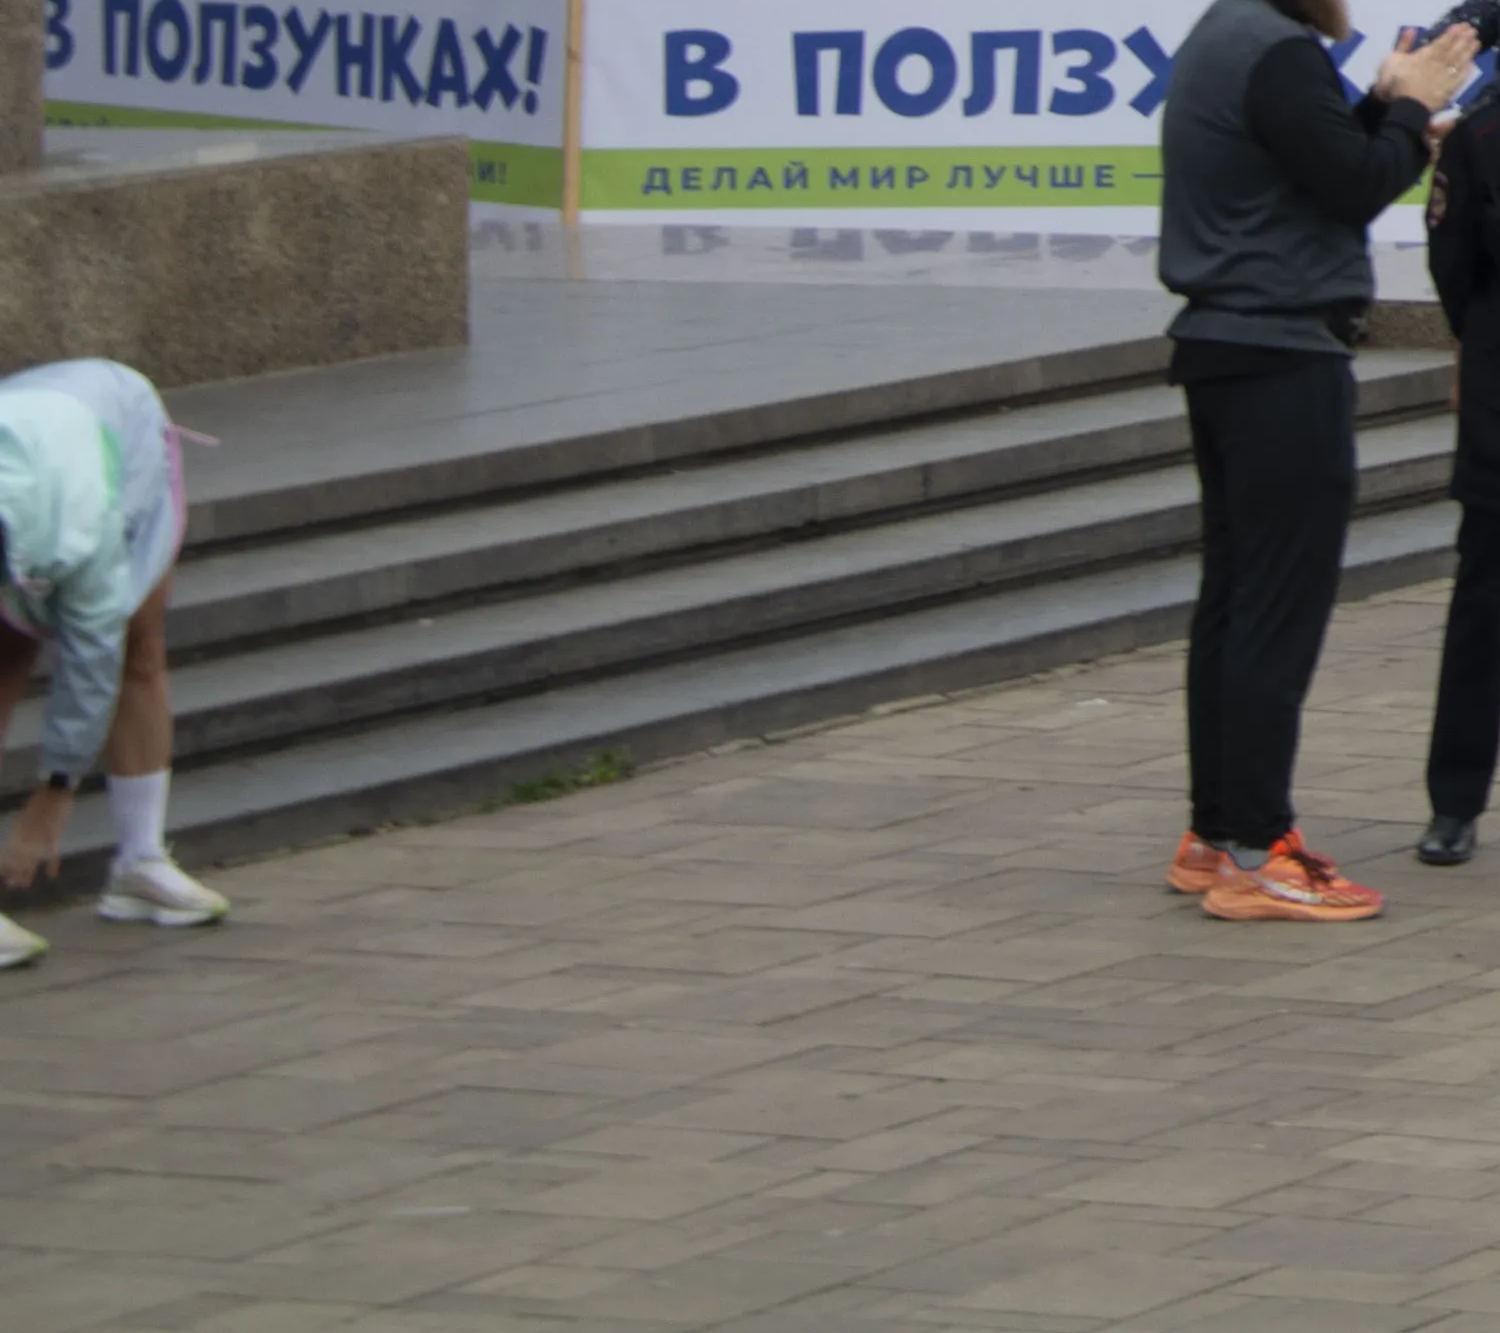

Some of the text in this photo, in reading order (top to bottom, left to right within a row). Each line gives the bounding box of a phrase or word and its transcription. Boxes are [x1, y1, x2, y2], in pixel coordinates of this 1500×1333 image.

[663, 27, 741, 117] В
[641, 161, 1116, 196] ДЕЛАЙ МИР ЛУЧШЕ
